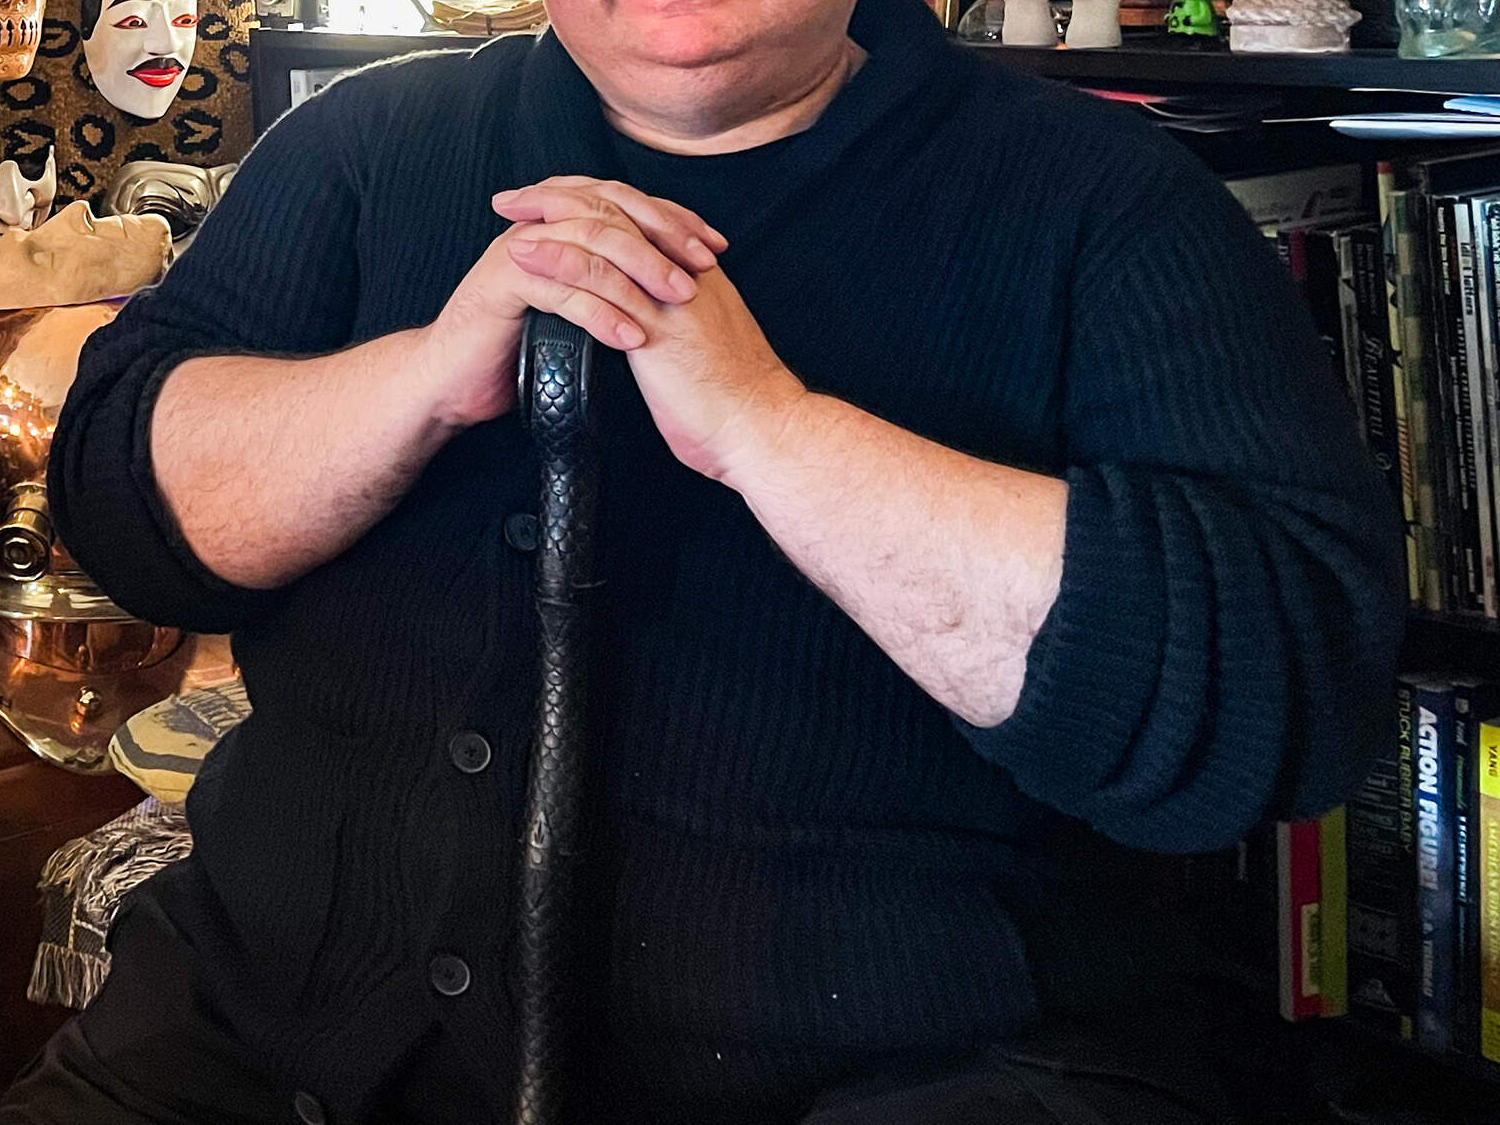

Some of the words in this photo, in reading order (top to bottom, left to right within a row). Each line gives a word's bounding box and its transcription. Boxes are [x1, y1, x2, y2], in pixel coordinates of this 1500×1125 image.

[1464, 275, 1476, 316] letters
[1397, 688, 1412, 741] STUCK
[1398, 743, 1413, 808] RUBBER
[1418, 705, 1439, 795] ACTION
[1488, 744, 1499, 777] YANG
[1417, 797, 1439, 891] FIGURE!
